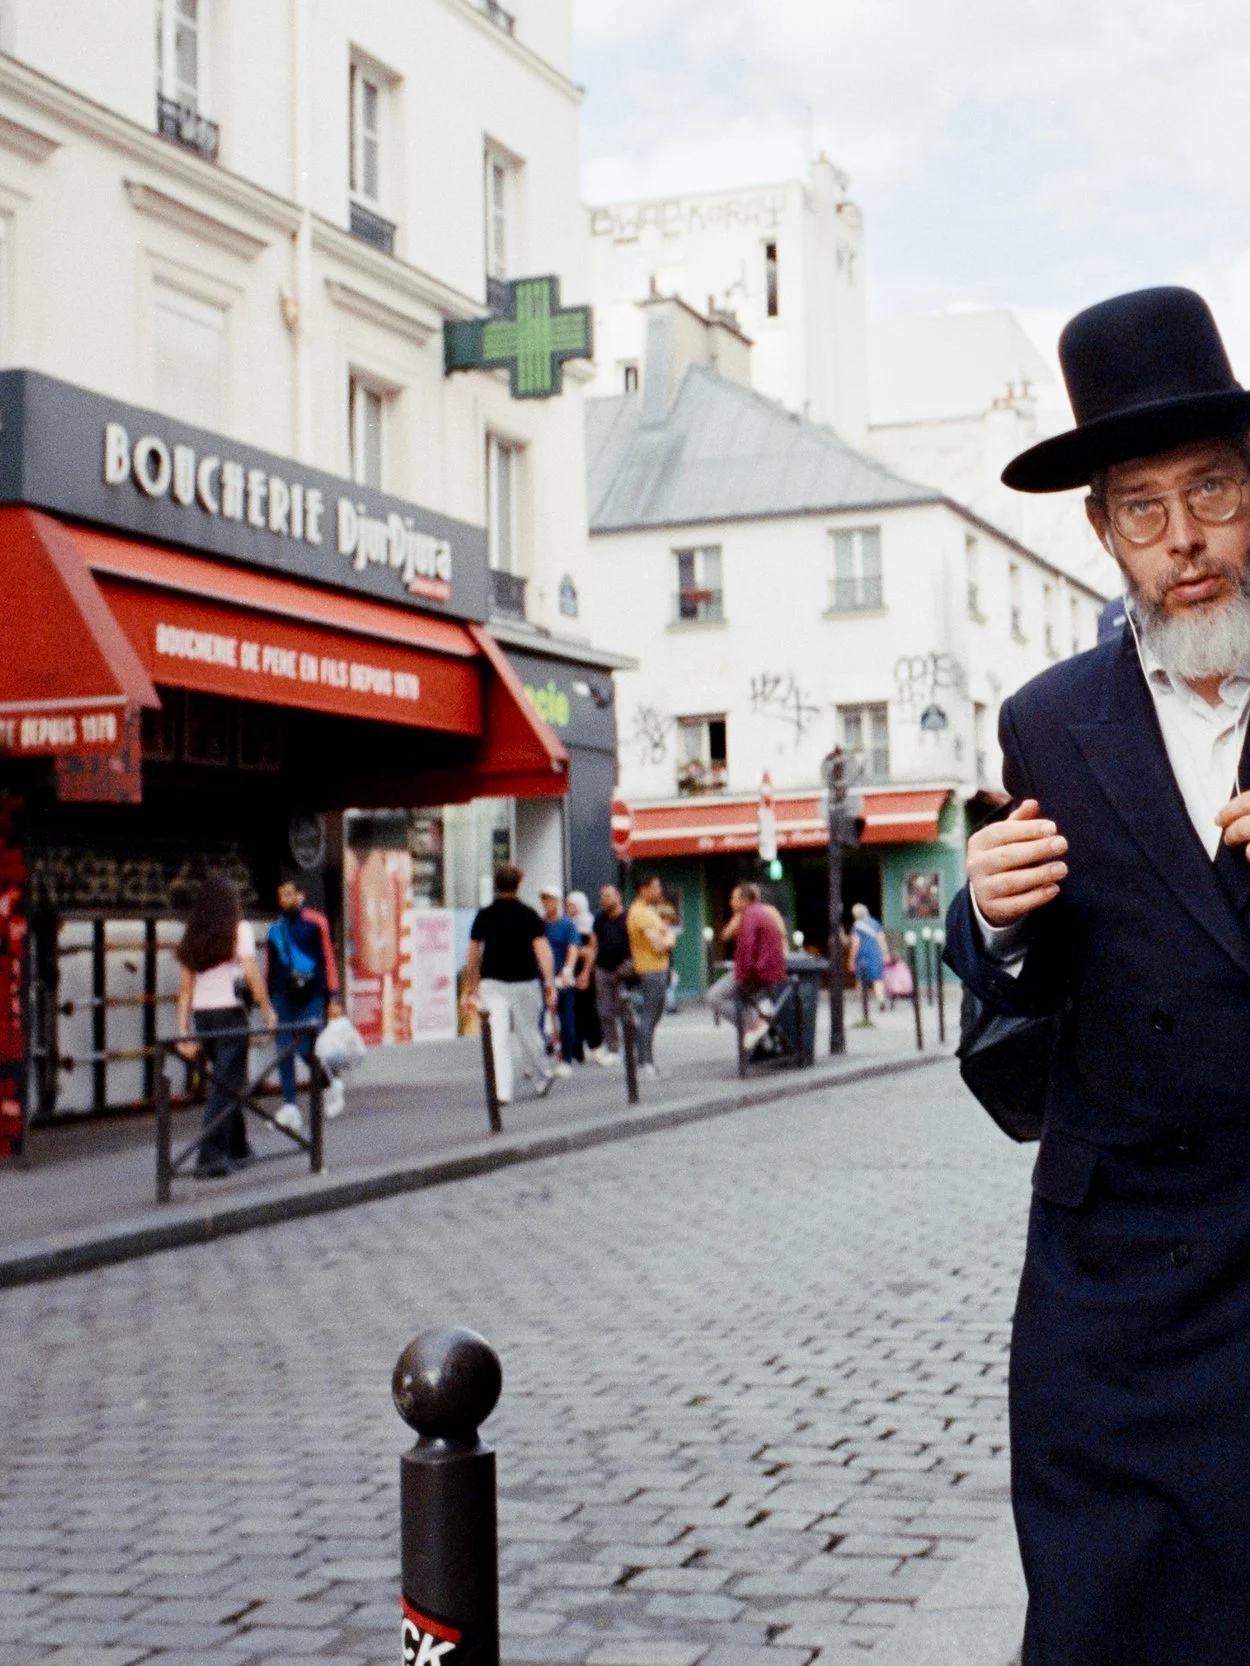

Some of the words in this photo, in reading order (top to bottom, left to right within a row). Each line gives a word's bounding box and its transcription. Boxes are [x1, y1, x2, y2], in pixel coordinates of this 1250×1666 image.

[105, 421, 323, 545] BOUCHERIE
[336, 498, 452, 584] DjurDjura
[21, 714, 77, 748] DEPUIS
